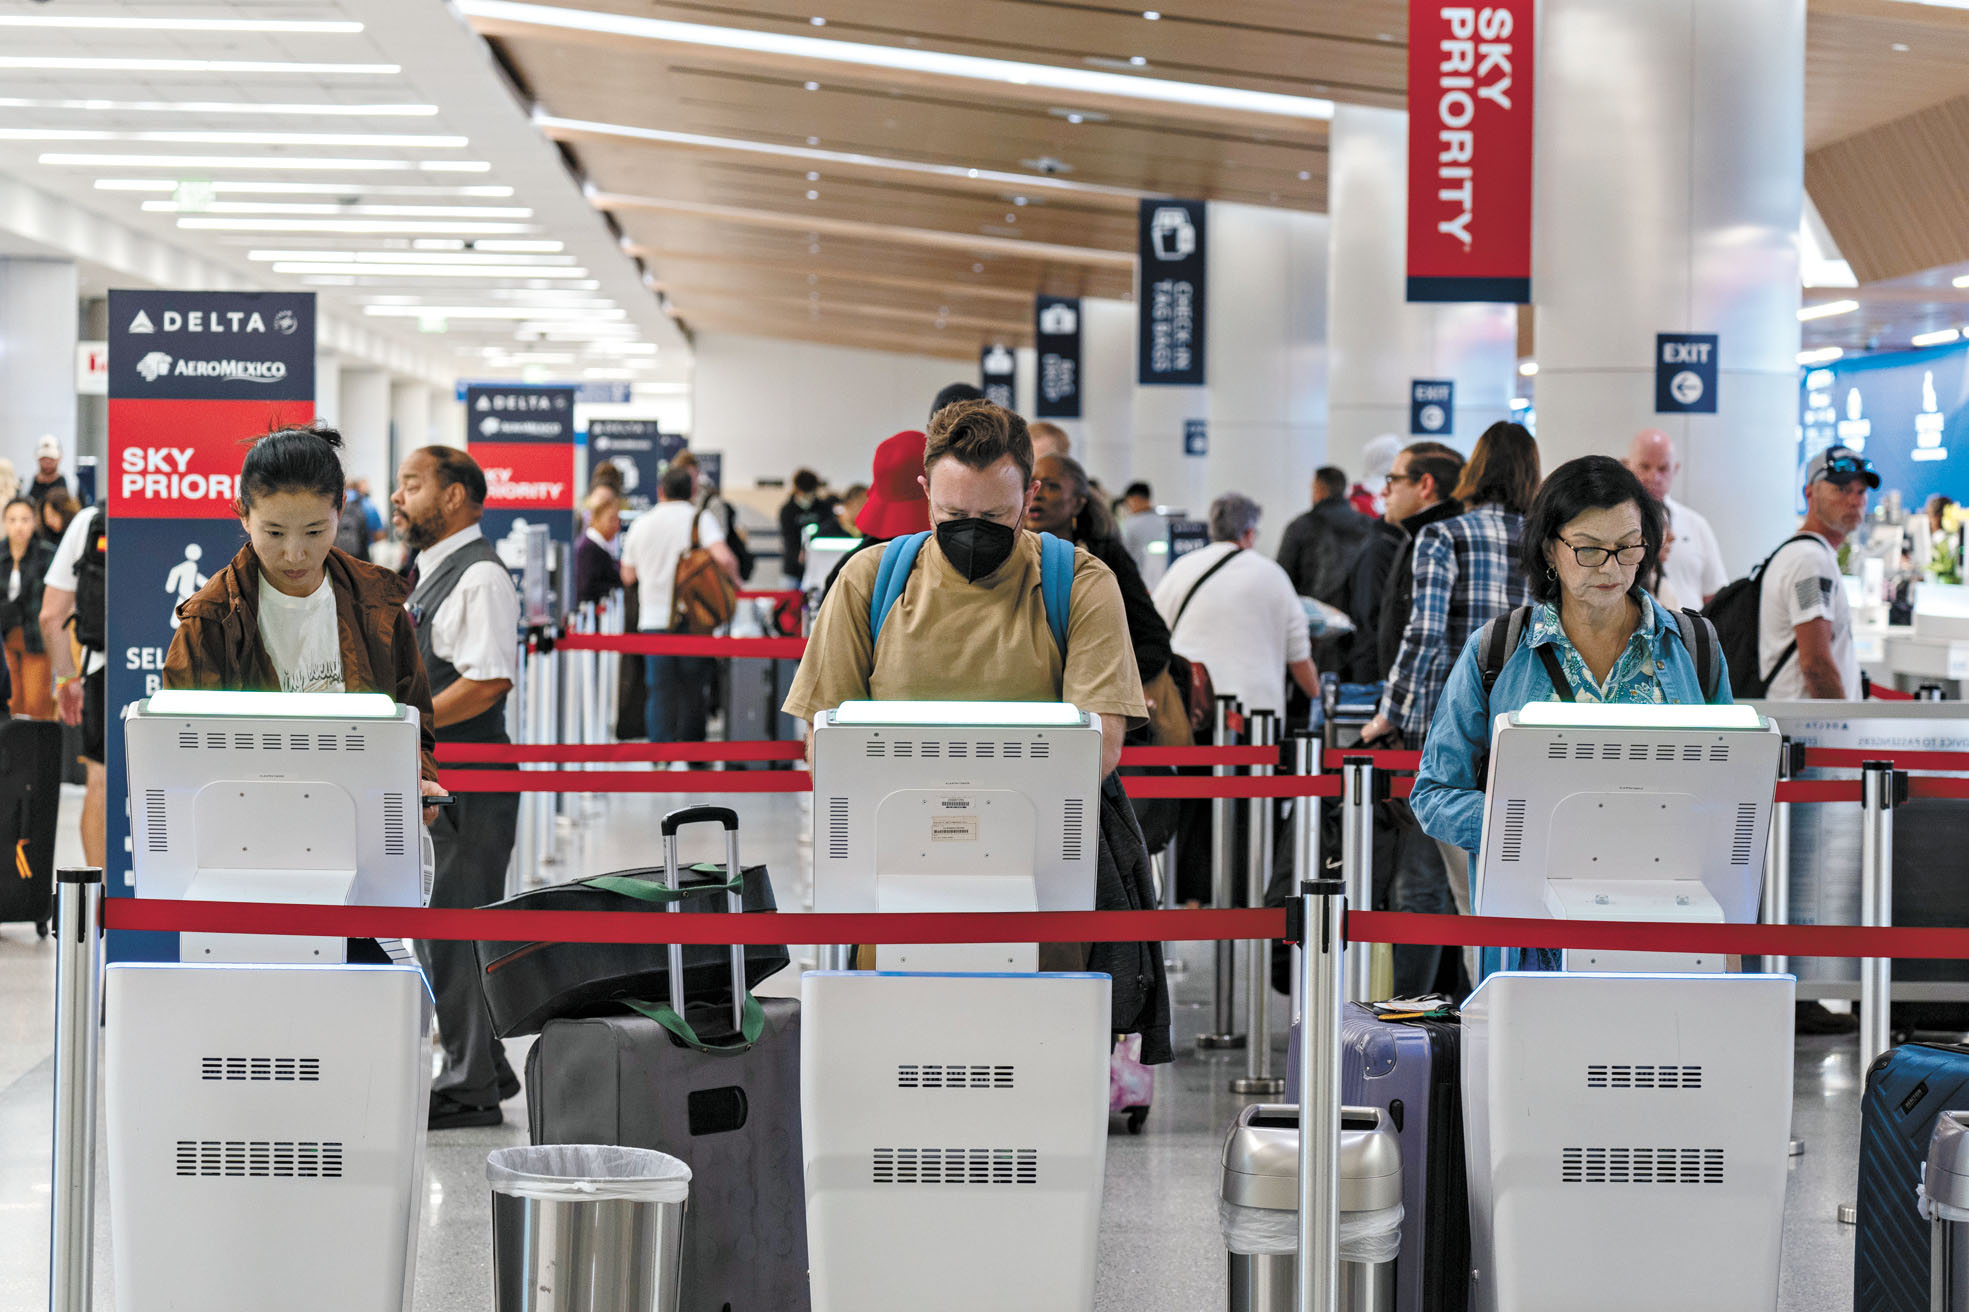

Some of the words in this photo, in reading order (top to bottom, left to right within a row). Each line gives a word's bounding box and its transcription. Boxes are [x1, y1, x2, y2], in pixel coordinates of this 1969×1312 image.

[1477, 6, 1513, 110] SKY
[1437, 6, 1475, 247] PRIORITY
[163, 311, 266, 333] DELTA
[1663, 342, 1712, 364] EXIT
[492, 394, 551, 411] DELTA
[1415, 384, 1449, 401] EXIT
[122, 446, 195, 473] SKY
[484, 467, 513, 482] KY
